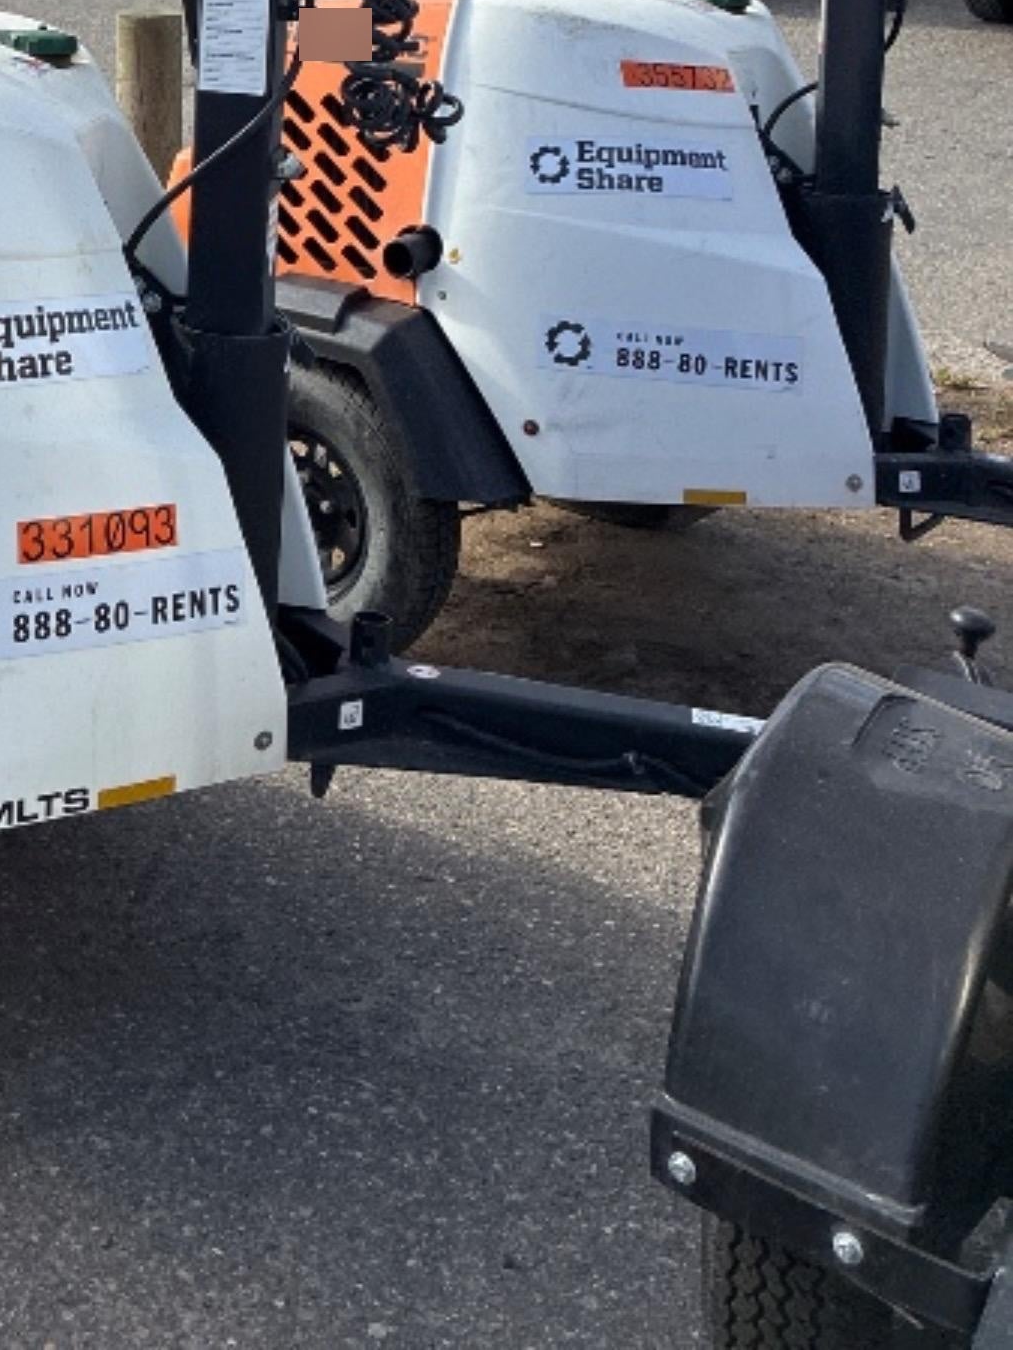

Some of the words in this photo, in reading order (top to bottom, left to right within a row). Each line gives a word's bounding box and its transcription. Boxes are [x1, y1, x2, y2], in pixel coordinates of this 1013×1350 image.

[576, 140, 728, 170] Equipment
[576, 168, 663, 192] Share
[616, 347, 799, 384] 888-80-RENTS
[22, 506, 175, 561] 331093
[13, 587, 54, 604] CALL
[62, 581, 98, 599] NOW
[13, 584, 240, 643] 888-80-RENTS
